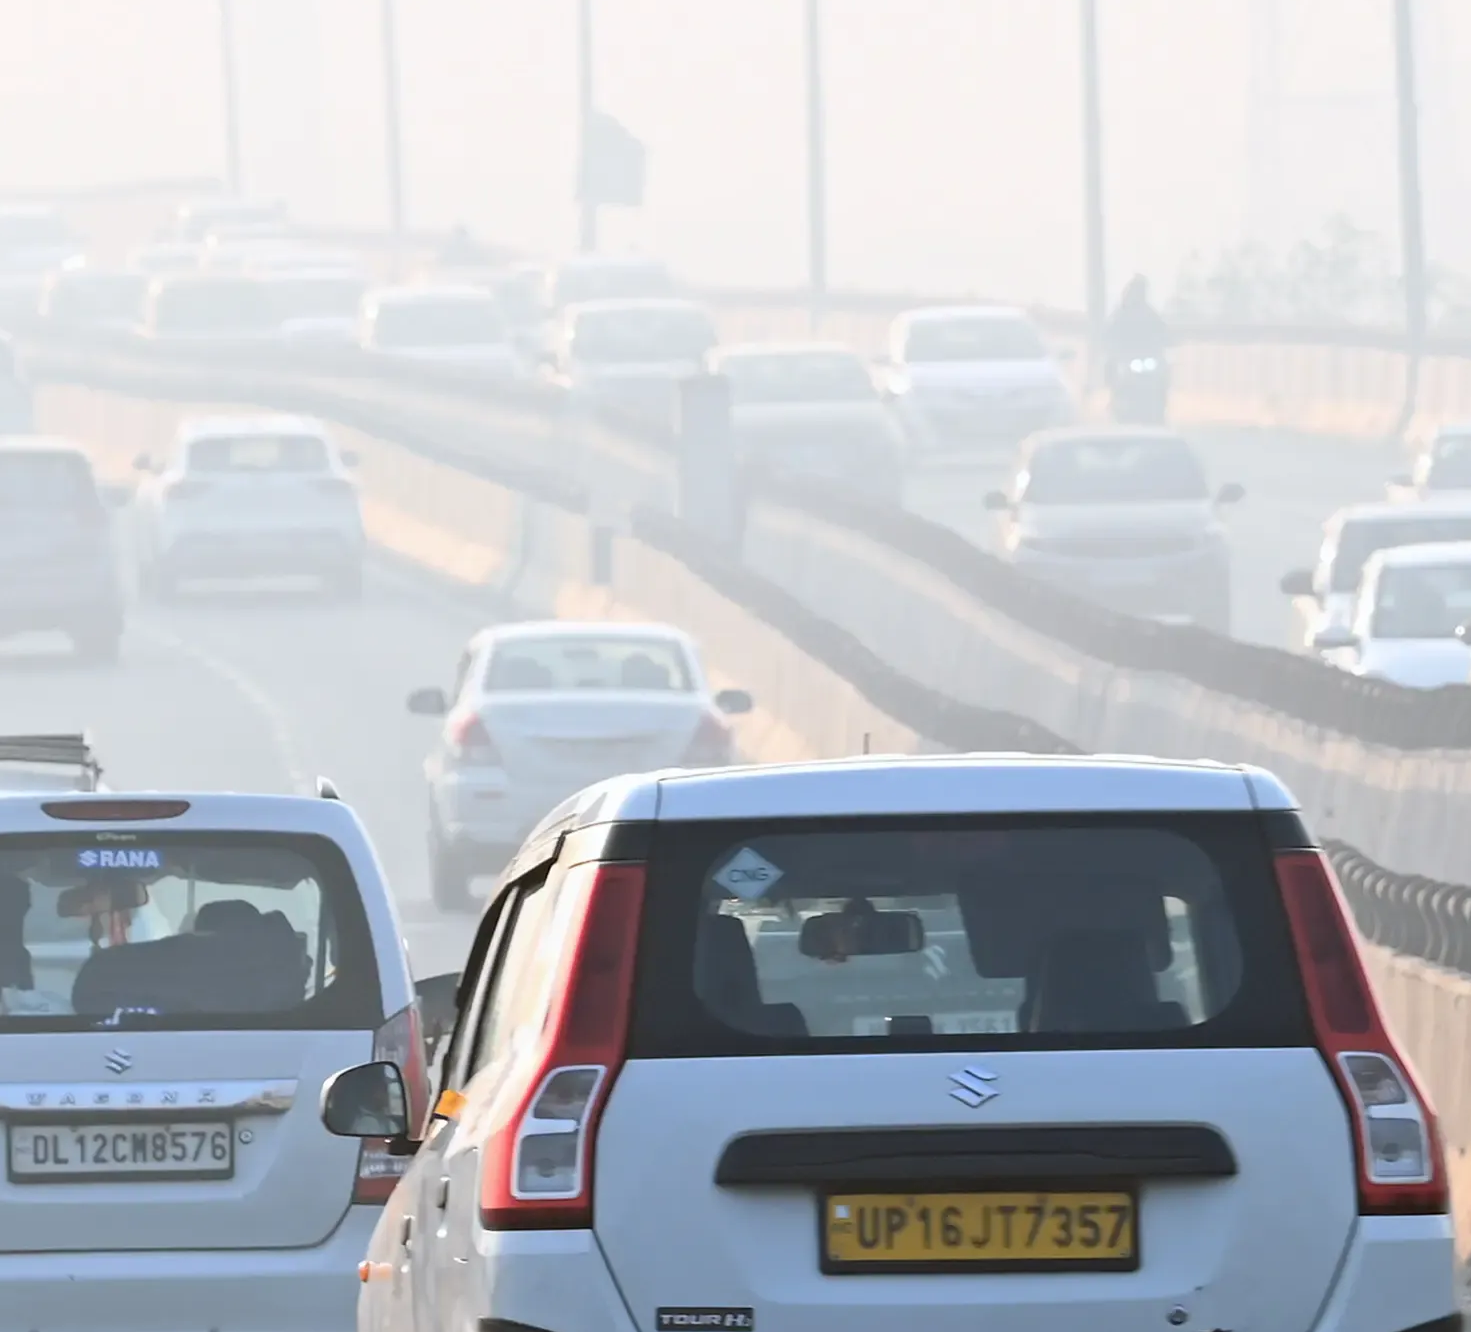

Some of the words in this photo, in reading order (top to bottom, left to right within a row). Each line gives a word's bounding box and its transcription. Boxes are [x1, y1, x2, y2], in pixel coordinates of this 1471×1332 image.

[99, 849, 160, 868] RANA
[728, 867, 770, 883] CNG
[855, 1204, 1130, 1251] UP16JT7357
[659, 1313, 722, 1326] TOUR
